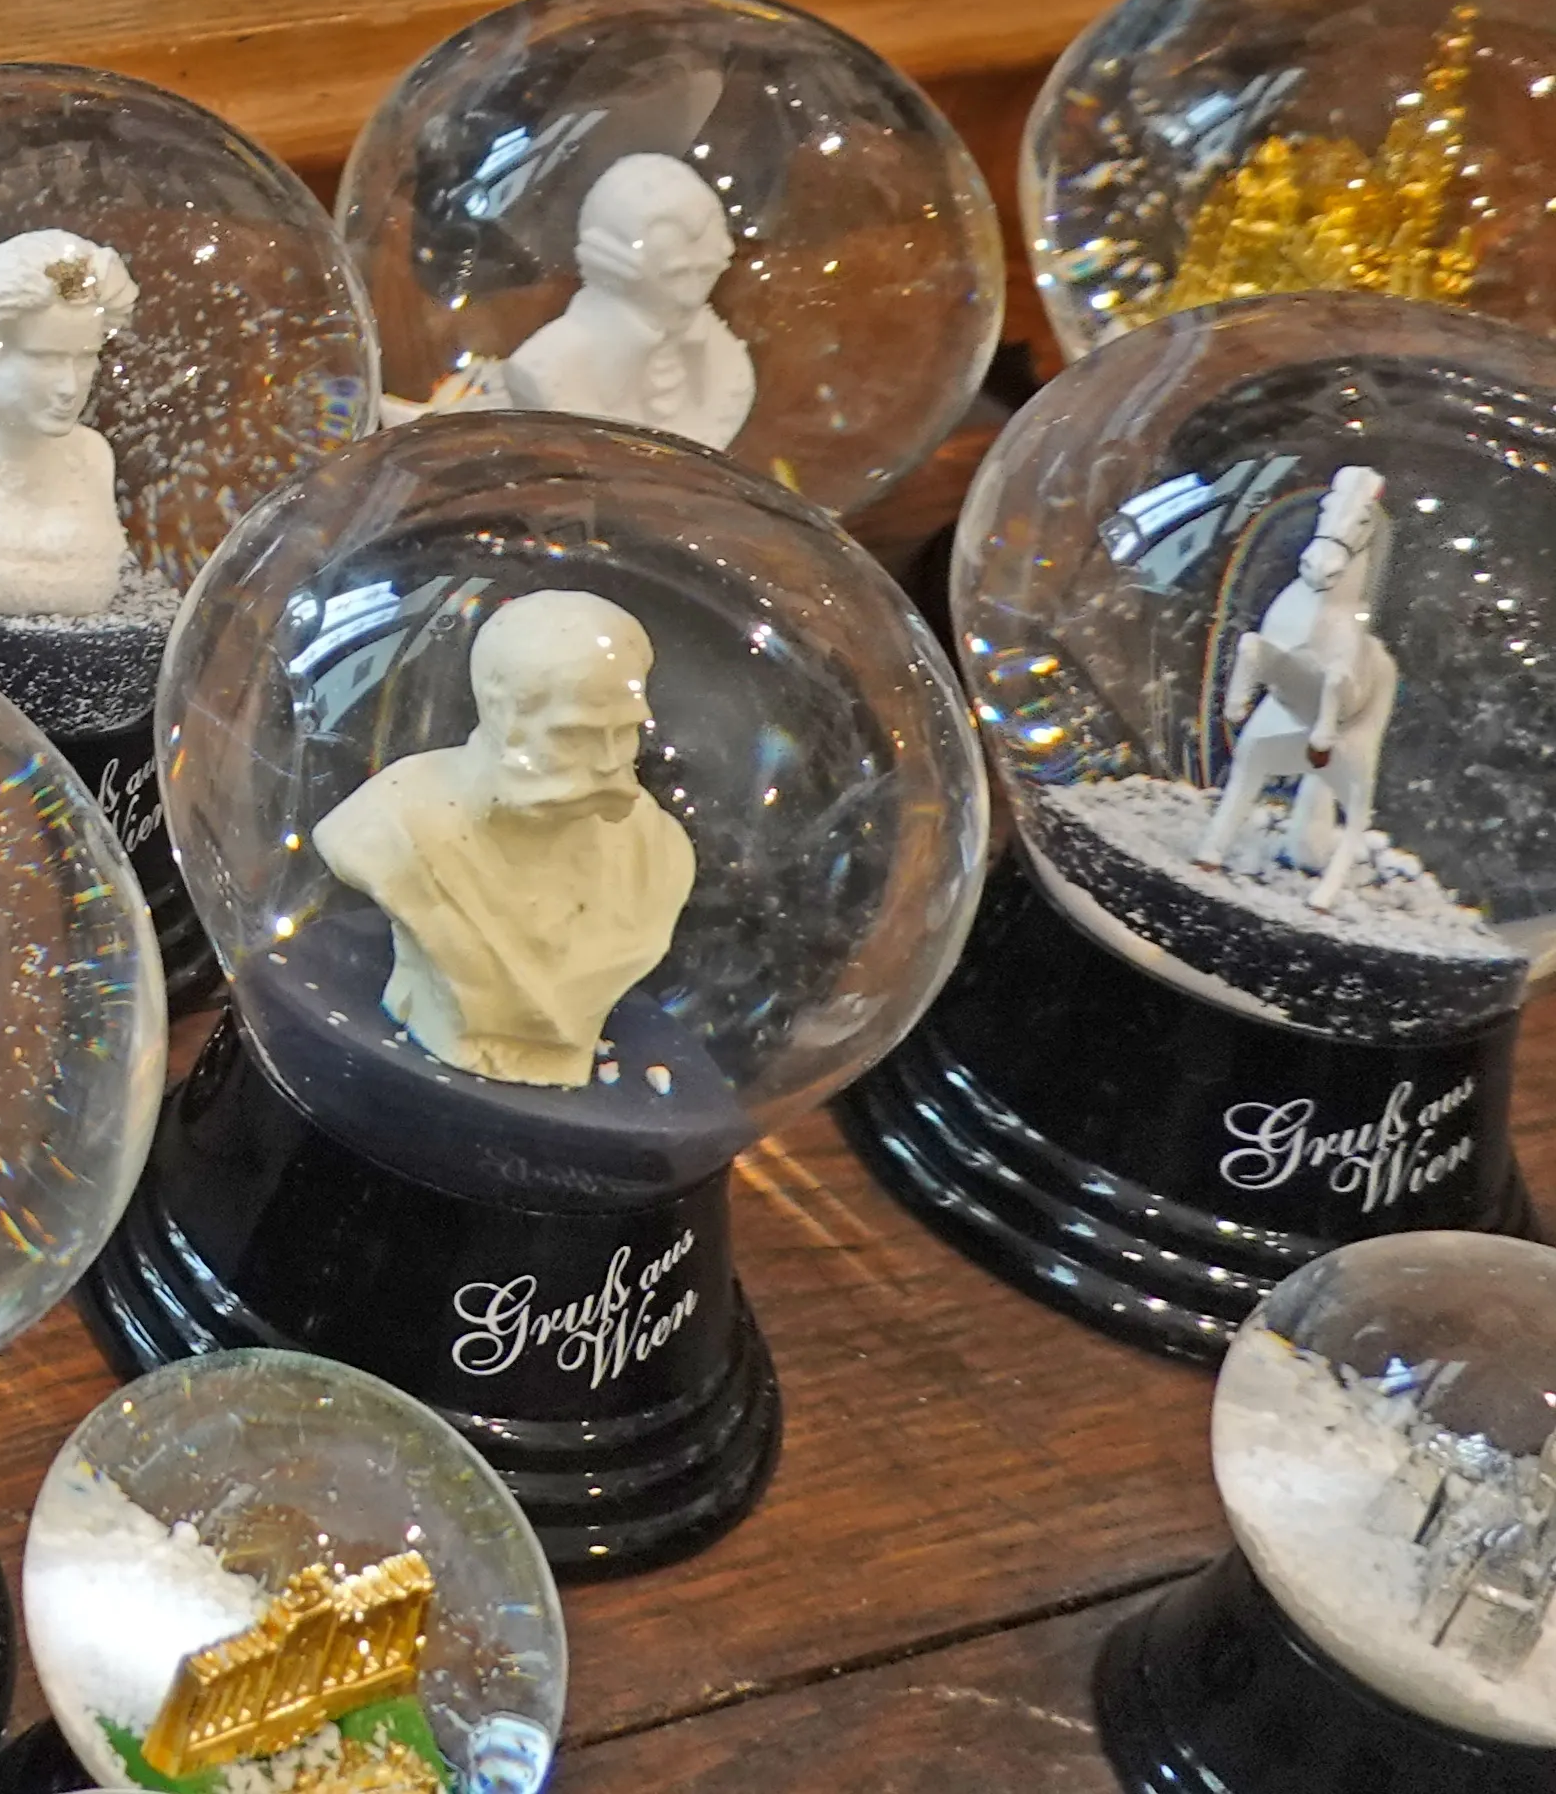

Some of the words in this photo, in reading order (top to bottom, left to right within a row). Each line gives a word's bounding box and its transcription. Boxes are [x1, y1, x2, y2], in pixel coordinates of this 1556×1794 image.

[1220, 1081, 1414, 1190] Gruß
[1417, 1076, 1474, 1127] aus
[1329, 1128, 1473, 1212] Wien
[451, 1245, 632, 1376] Gruß
[639, 1228, 695, 1290] aus
[556, 1289, 699, 1390] Wien
